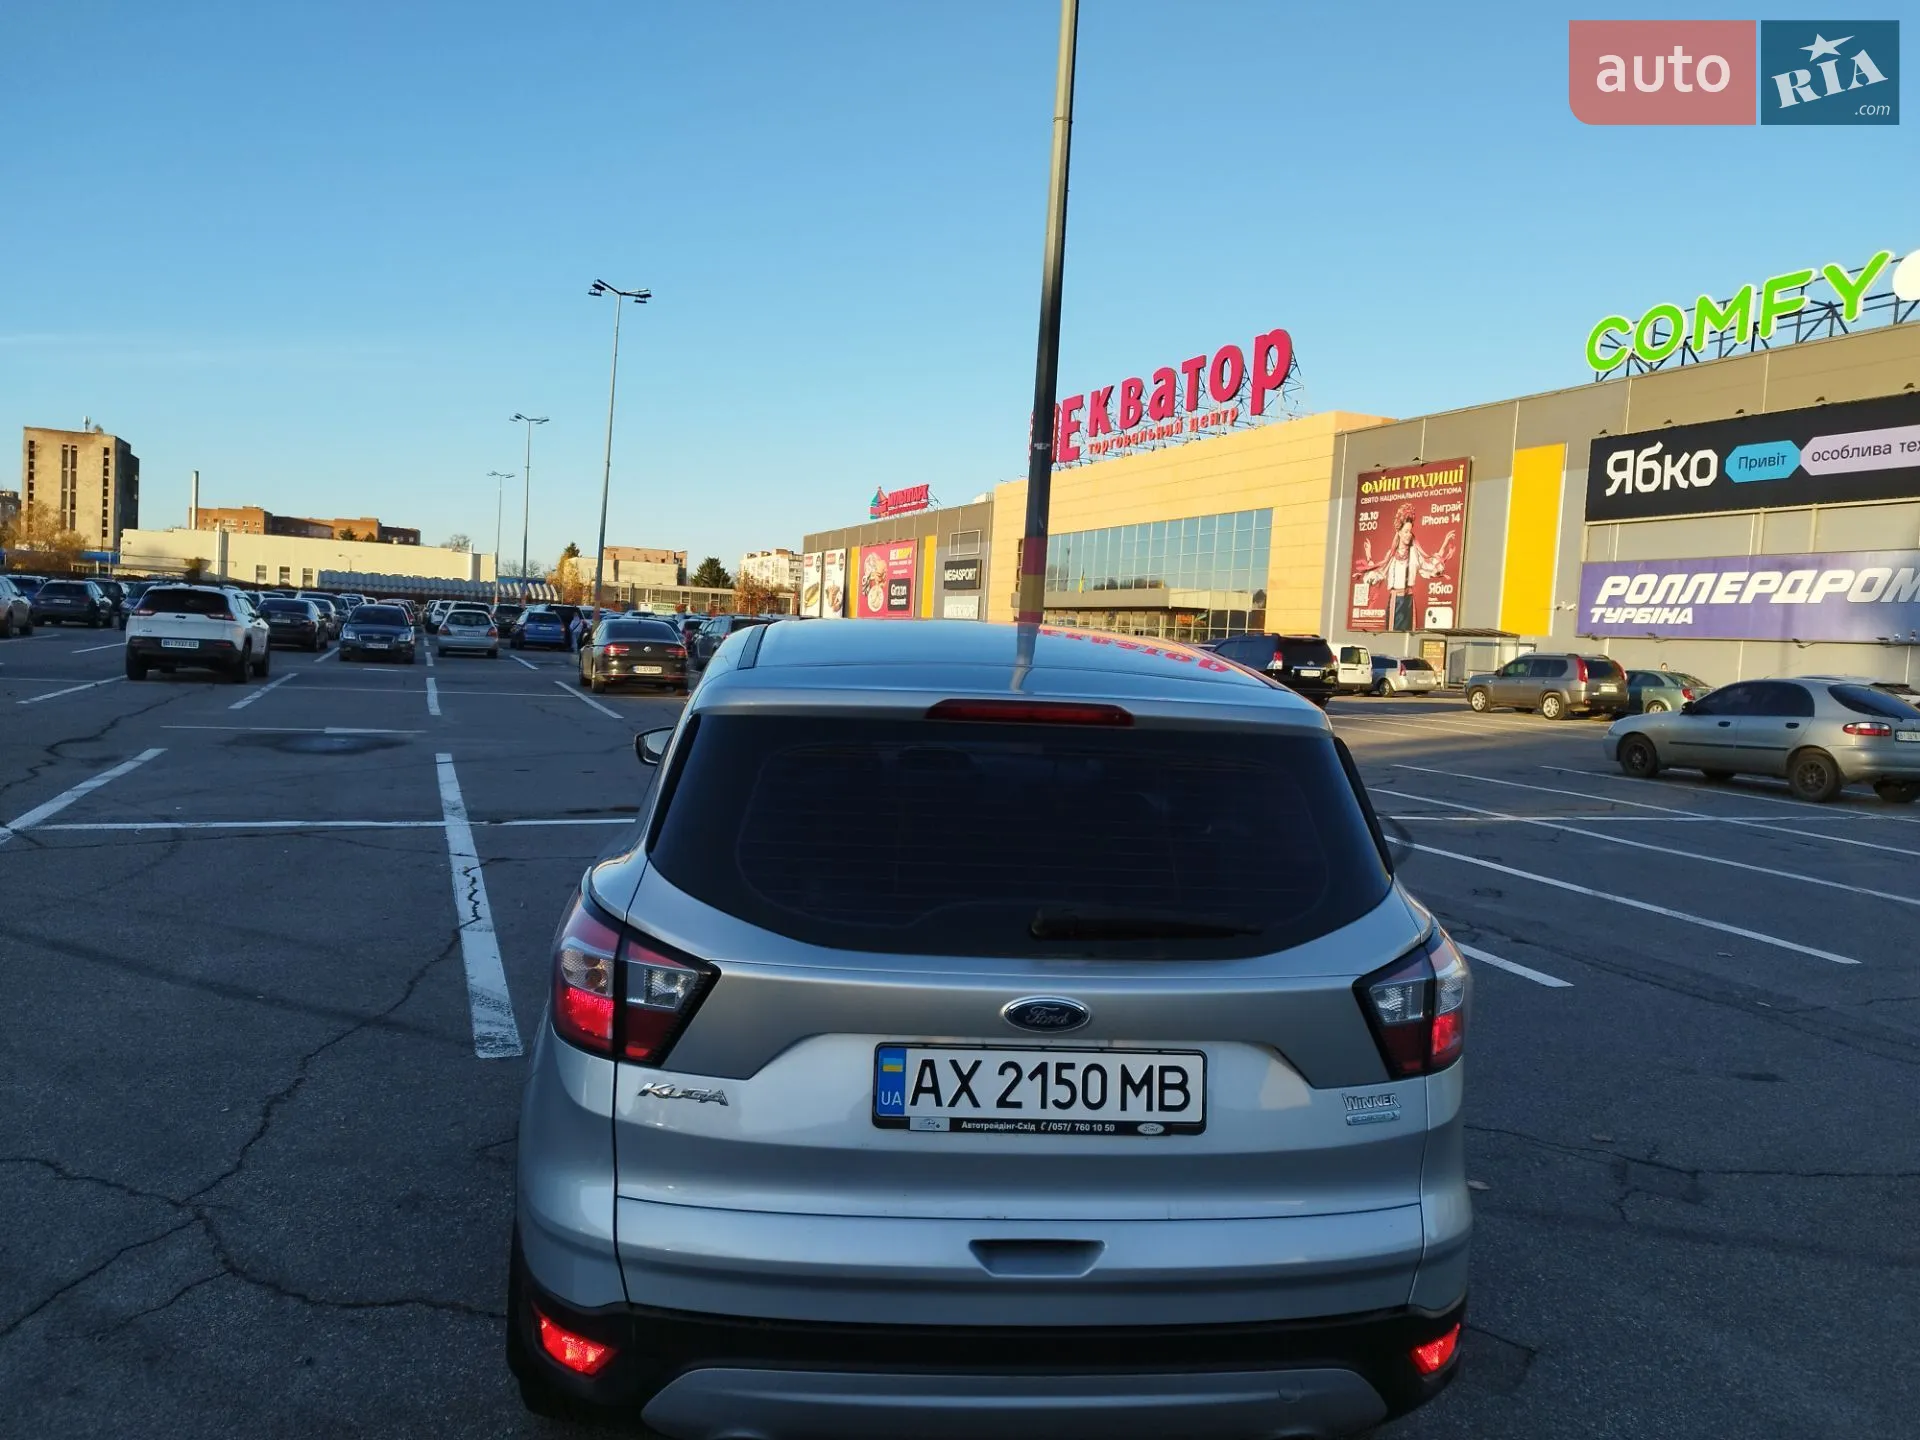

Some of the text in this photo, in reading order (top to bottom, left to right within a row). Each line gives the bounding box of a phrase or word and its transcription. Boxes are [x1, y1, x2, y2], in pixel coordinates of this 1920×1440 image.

[1585, 249, 1895, 373] COMFY
[1088, 407, 1239, 455] торговельний центр
[1737, 451, 1788, 471] Привіт
[1811, 444, 1892, 462] особлива
[1605, 441, 1718, 497] Ябко
[1361, 464, 1464, 495] ФАЙНІ ТРАДИЦІЇ
[1360, 486, 1462, 505] СВЯТО НАЦІОНАЛЬНОГО КОСТЮМА
[1359, 511, 1379, 522] 28.10
[1431, 501, 1464, 514] Виграй
[1359, 521, 1378, 531] 12:00
[1422, 513, 1461, 526] iPhone 14
[944, 567, 977, 581] MEGASPORT
[1595, 567, 1920, 605] РОЛЛЕРДРОМ
[1590, 607, 1693, 625] ТУРБІНА
[1025, 1006, 1070, 1024] Ford
[909, 1058, 1191, 1113] AX 2150 MB
[881, 1091, 903, 1106] UA
[1341, 1092, 1401, 1111] WINNER
[1074, 1123, 1090, 1132] 760
[1092, 1123, 1102, 1132] 10
[1104, 1123, 1116, 1132] 50
